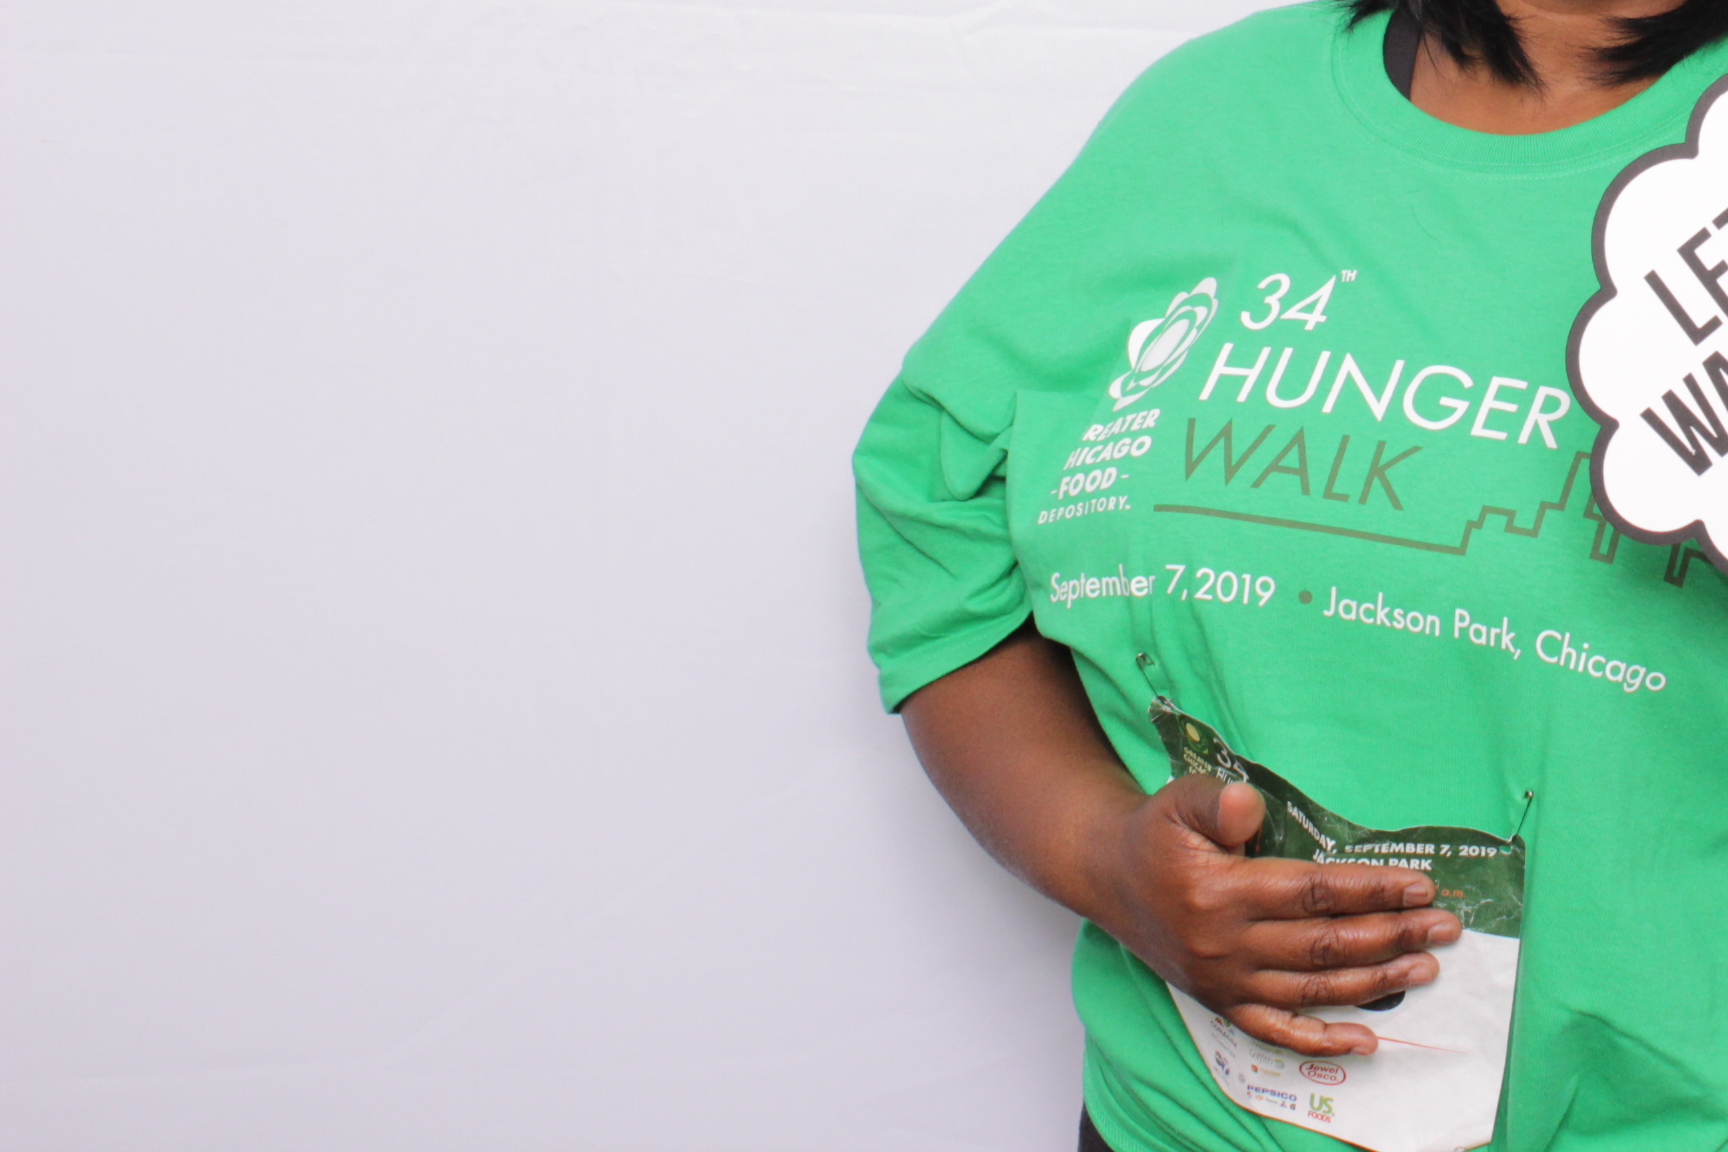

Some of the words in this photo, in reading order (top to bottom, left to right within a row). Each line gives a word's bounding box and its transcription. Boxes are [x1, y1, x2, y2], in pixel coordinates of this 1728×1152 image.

[1198, 342, 1572, 449] HUNGER
[1081, 408, 1161, 441] REATER
[1062, 435, 1152, 471] HICAGO
[1184, 417, 1424, 511] WALK
[1050, 563, 1155, 609] September
[1322, 586, 1440, 636] Jackson
[1453, 608, 1521, 660] Park,
[1535, 630, 1667, 693] Chicago
[1286, 801, 1338, 854] SATURDAY,
[1344, 843, 1435, 854] SEPTEMBER
[1440, 844, 1451, 857] 7,
[1458, 846, 1498, 858] 2019
[1388, 858, 1432, 871] PARK
[1305, 1063, 1339, 1074] Jewel
[1307, 1110, 1332, 1123] FOODS
